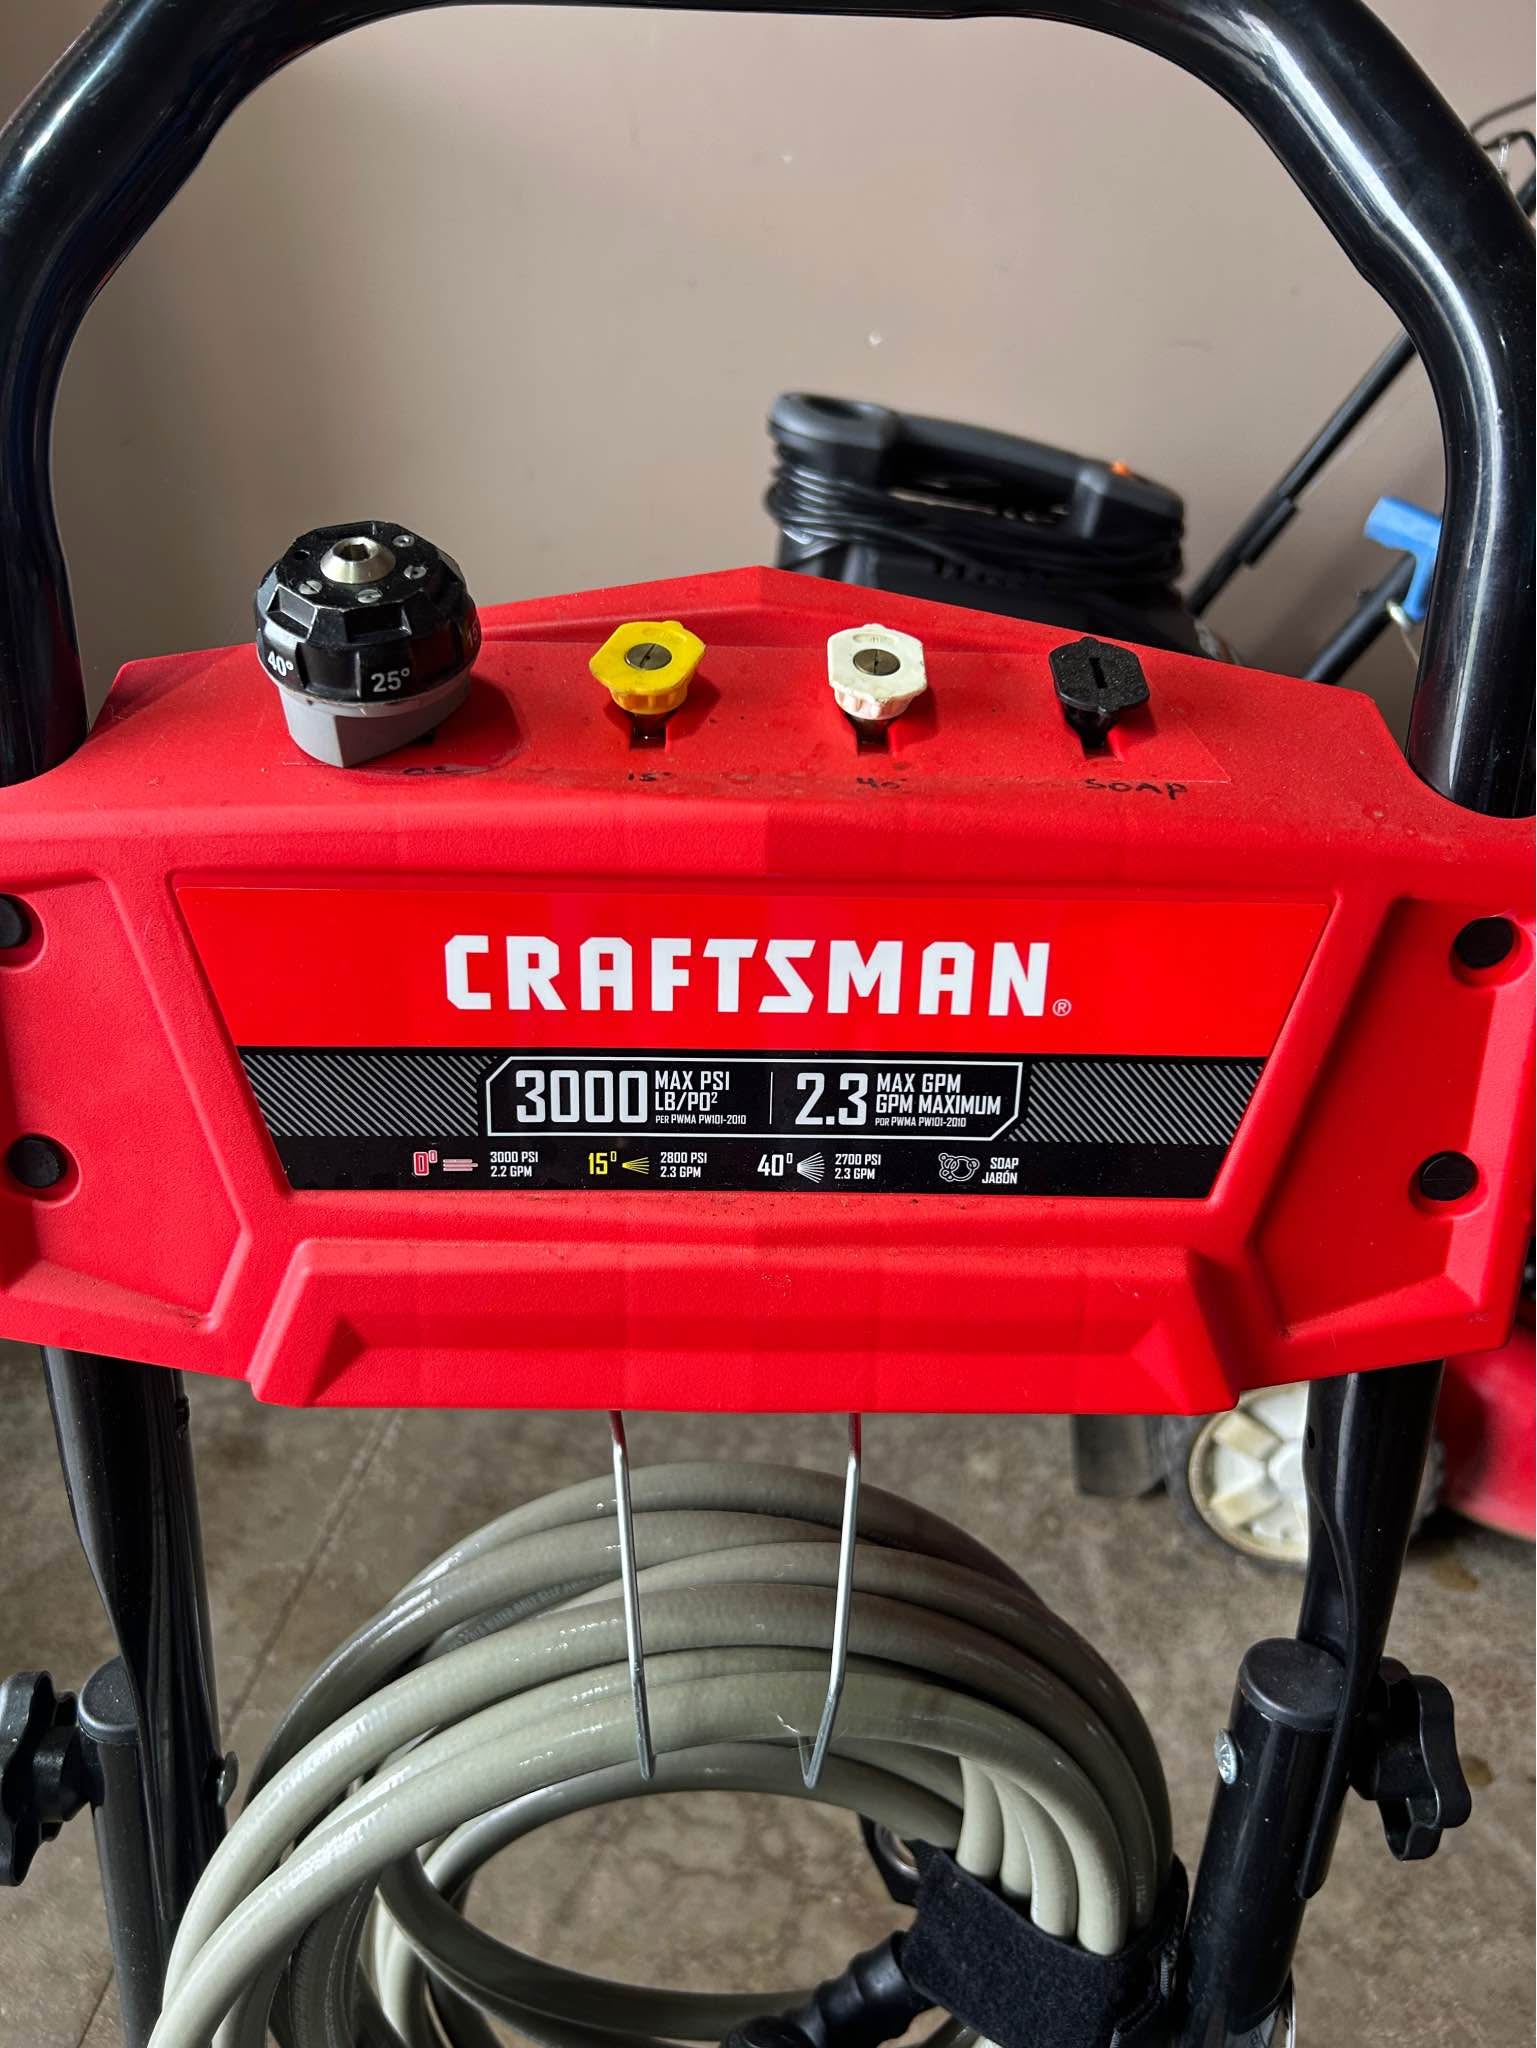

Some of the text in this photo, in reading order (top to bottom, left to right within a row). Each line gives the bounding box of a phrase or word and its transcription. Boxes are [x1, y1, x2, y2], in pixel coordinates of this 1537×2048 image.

[267, 651, 294, 677] 40°
[371, 668, 410, 693] 25°
[1085, 778, 1188, 800] SOAP
[655, 1070, 730, 1091] MAX PSI
[877, 1073, 961, 1093] MAX GPM
[515, 1069, 648, 1123] 3000
[795, 1072, 869, 1126] 2.3
[875, 1094, 1001, 1116] GPM MAXIMUM
[655, 1114, 747, 1125] PER PWMA PW101-2010
[875, 1117, 966, 1128] POR PWMA PW101-2010
[413, 1149, 438, 1176] 0°
[490, 1151, 539, 1163] 3000 PSI
[588, 1151, 617, 1175] 15°
[660, 1152, 707, 1164] 2800 PSI
[757, 1152, 793, 1176] 40°
[834, 1153, 881, 1166] 2700 PSI
[990, 1157, 1019, 1170] SOAP
[490, 1165, 533, 1177] 2.2 GPM
[660, 1166, 701, 1178] 2.3 GPM
[834, 1167, 876, 1180] 2.3 GPM
[981, 1170, 1018, 1184] JABÓN
